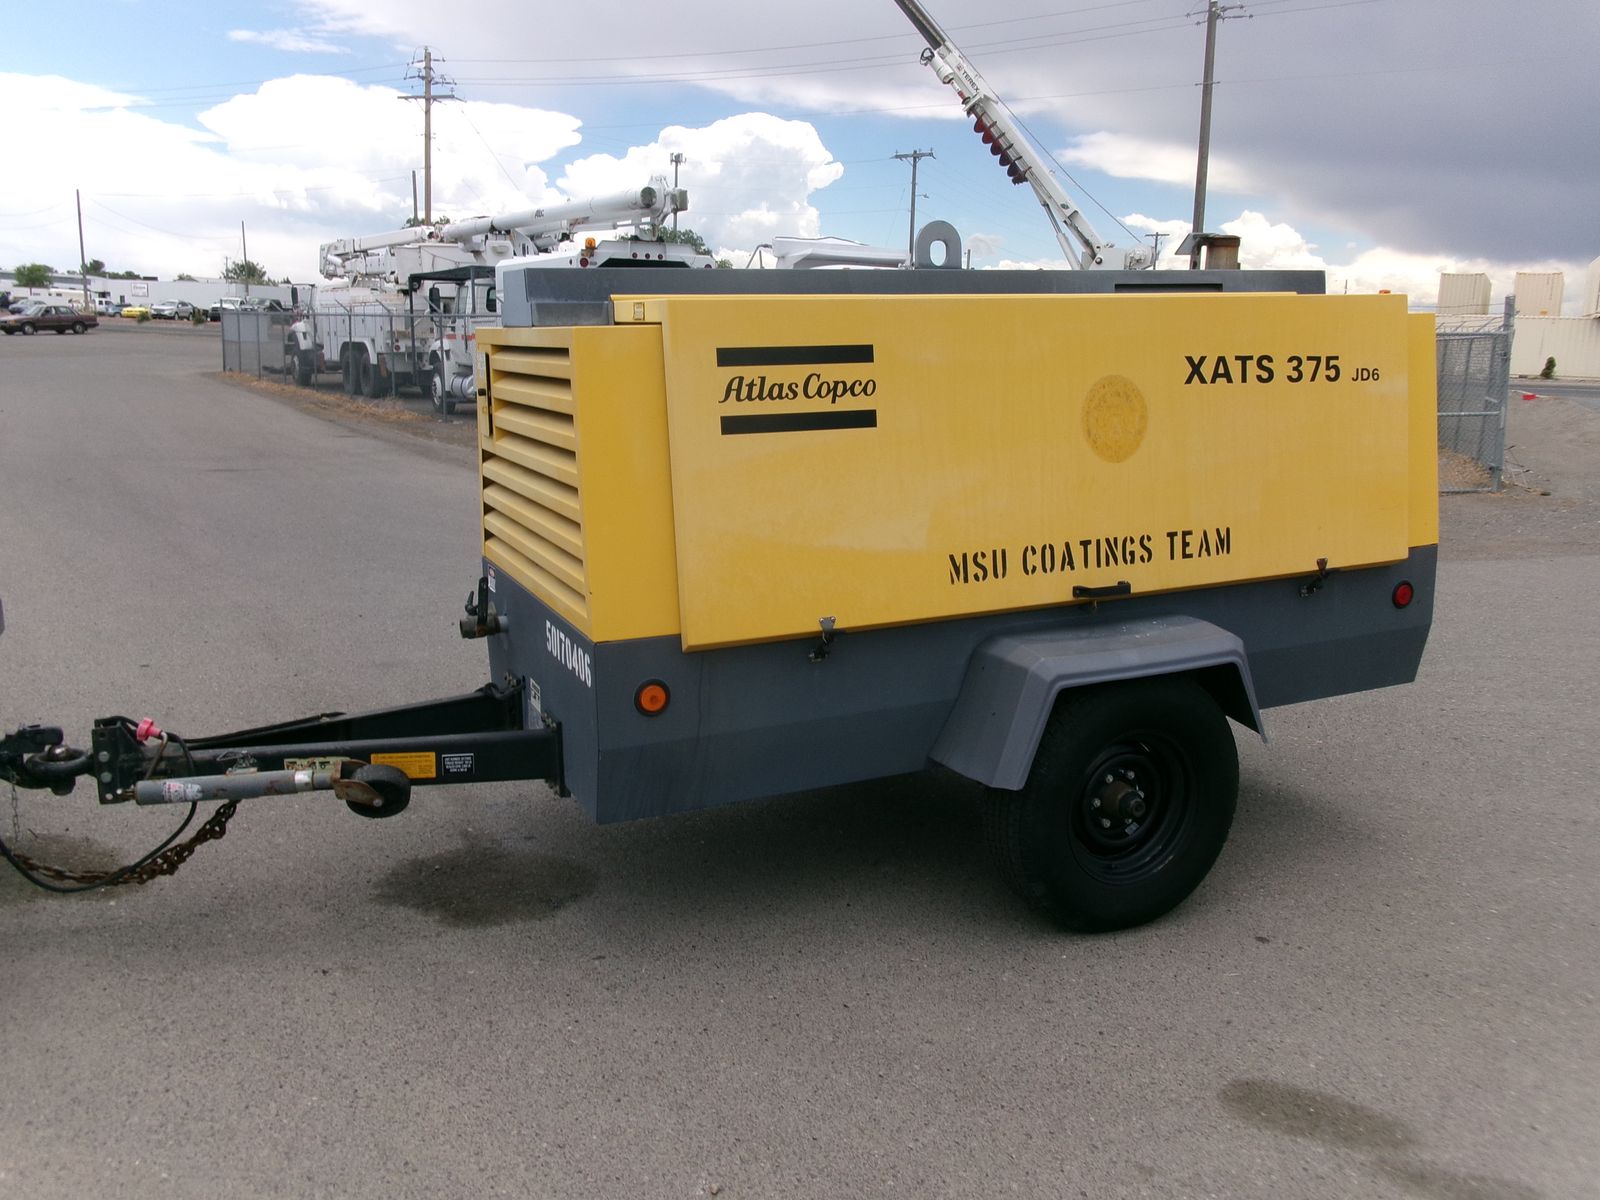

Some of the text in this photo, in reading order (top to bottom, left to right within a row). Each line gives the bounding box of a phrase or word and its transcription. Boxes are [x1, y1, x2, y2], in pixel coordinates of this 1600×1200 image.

[962, 70, 980, 93] TEREX
[1184, 355, 1380, 385] XATS 375 JD6
[718, 372, 877, 405] Atlas Copco
[948, 526, 1231, 585] MSU COATINGS TEAM
